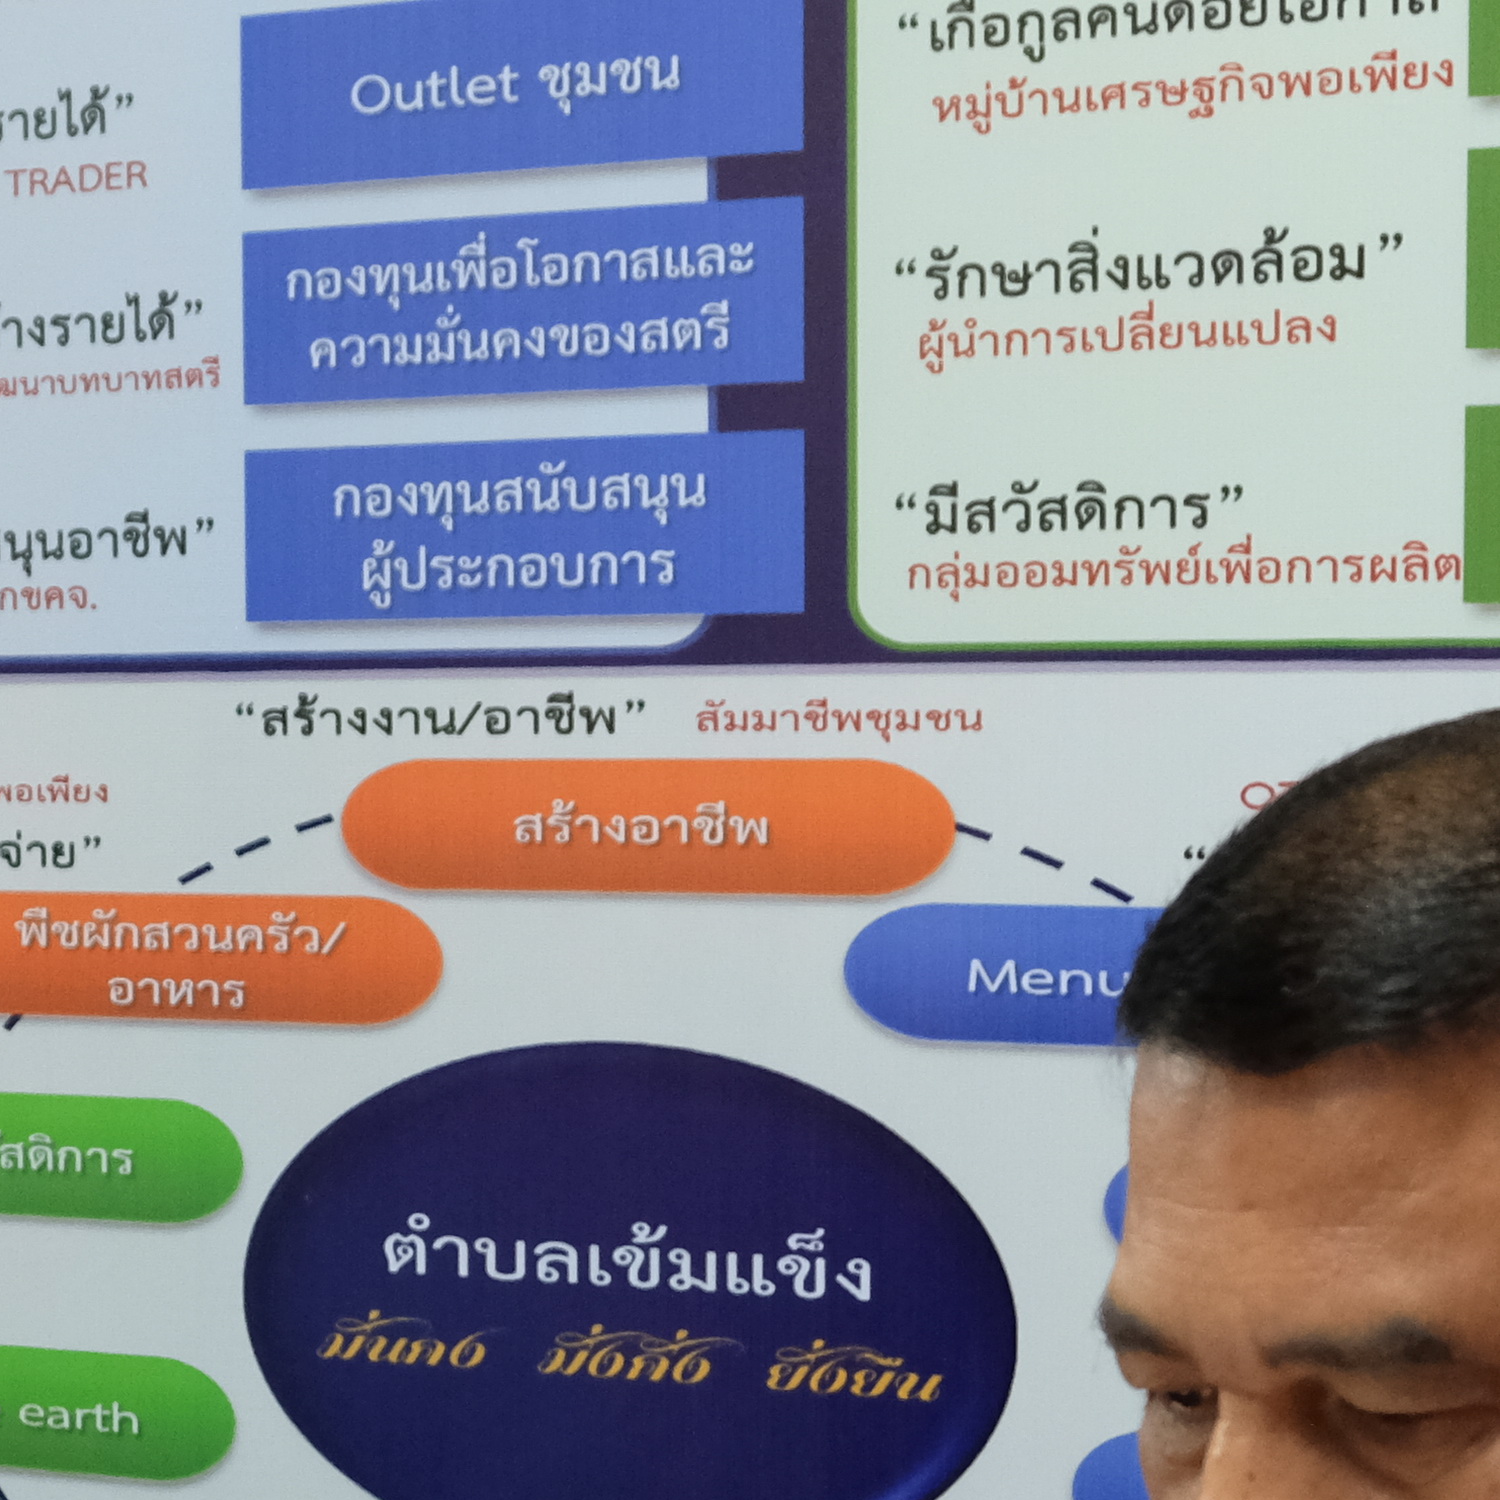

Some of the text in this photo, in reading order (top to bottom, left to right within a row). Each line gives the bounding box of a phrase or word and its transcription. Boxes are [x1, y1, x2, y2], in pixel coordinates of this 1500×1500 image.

[351, 53, 681, 116] Outlet ชุมชน
[932, 48, 1456, 136] หมู่บ้านเศรษฐกิจพอเพียง
[4, 159, 148, 197] TRADER
[286, 232, 755, 311] กองทุนเพื่อโอกาสและ
[308, 301, 731, 369] ความมั่นคงของสตรี
[918, 300, 1338, 375] ผู้นำการเปลี่ยนแปลง
[333, 460, 708, 530] กองทุนสนับสนุน
[361, 538, 677, 609] ผู้ประกอบการ
[907, 533, 1461, 602] กลุ่มออมทรัพย์เพื่อการผลิต
[695, 698, 984, 743] สัมมาชีพชุมชน
[512, 798, 770, 847] สร้างอาชีพ
[13, 905, 347, 956] พืชผักสวนครัว/
[108, 974, 246, 1010] อาหาร
[967, 958, 1132, 998] Menu
[383, 1212, 873, 1301] ตำบลเข้มแข็ง
[19, 1401, 140, 1436] earth
